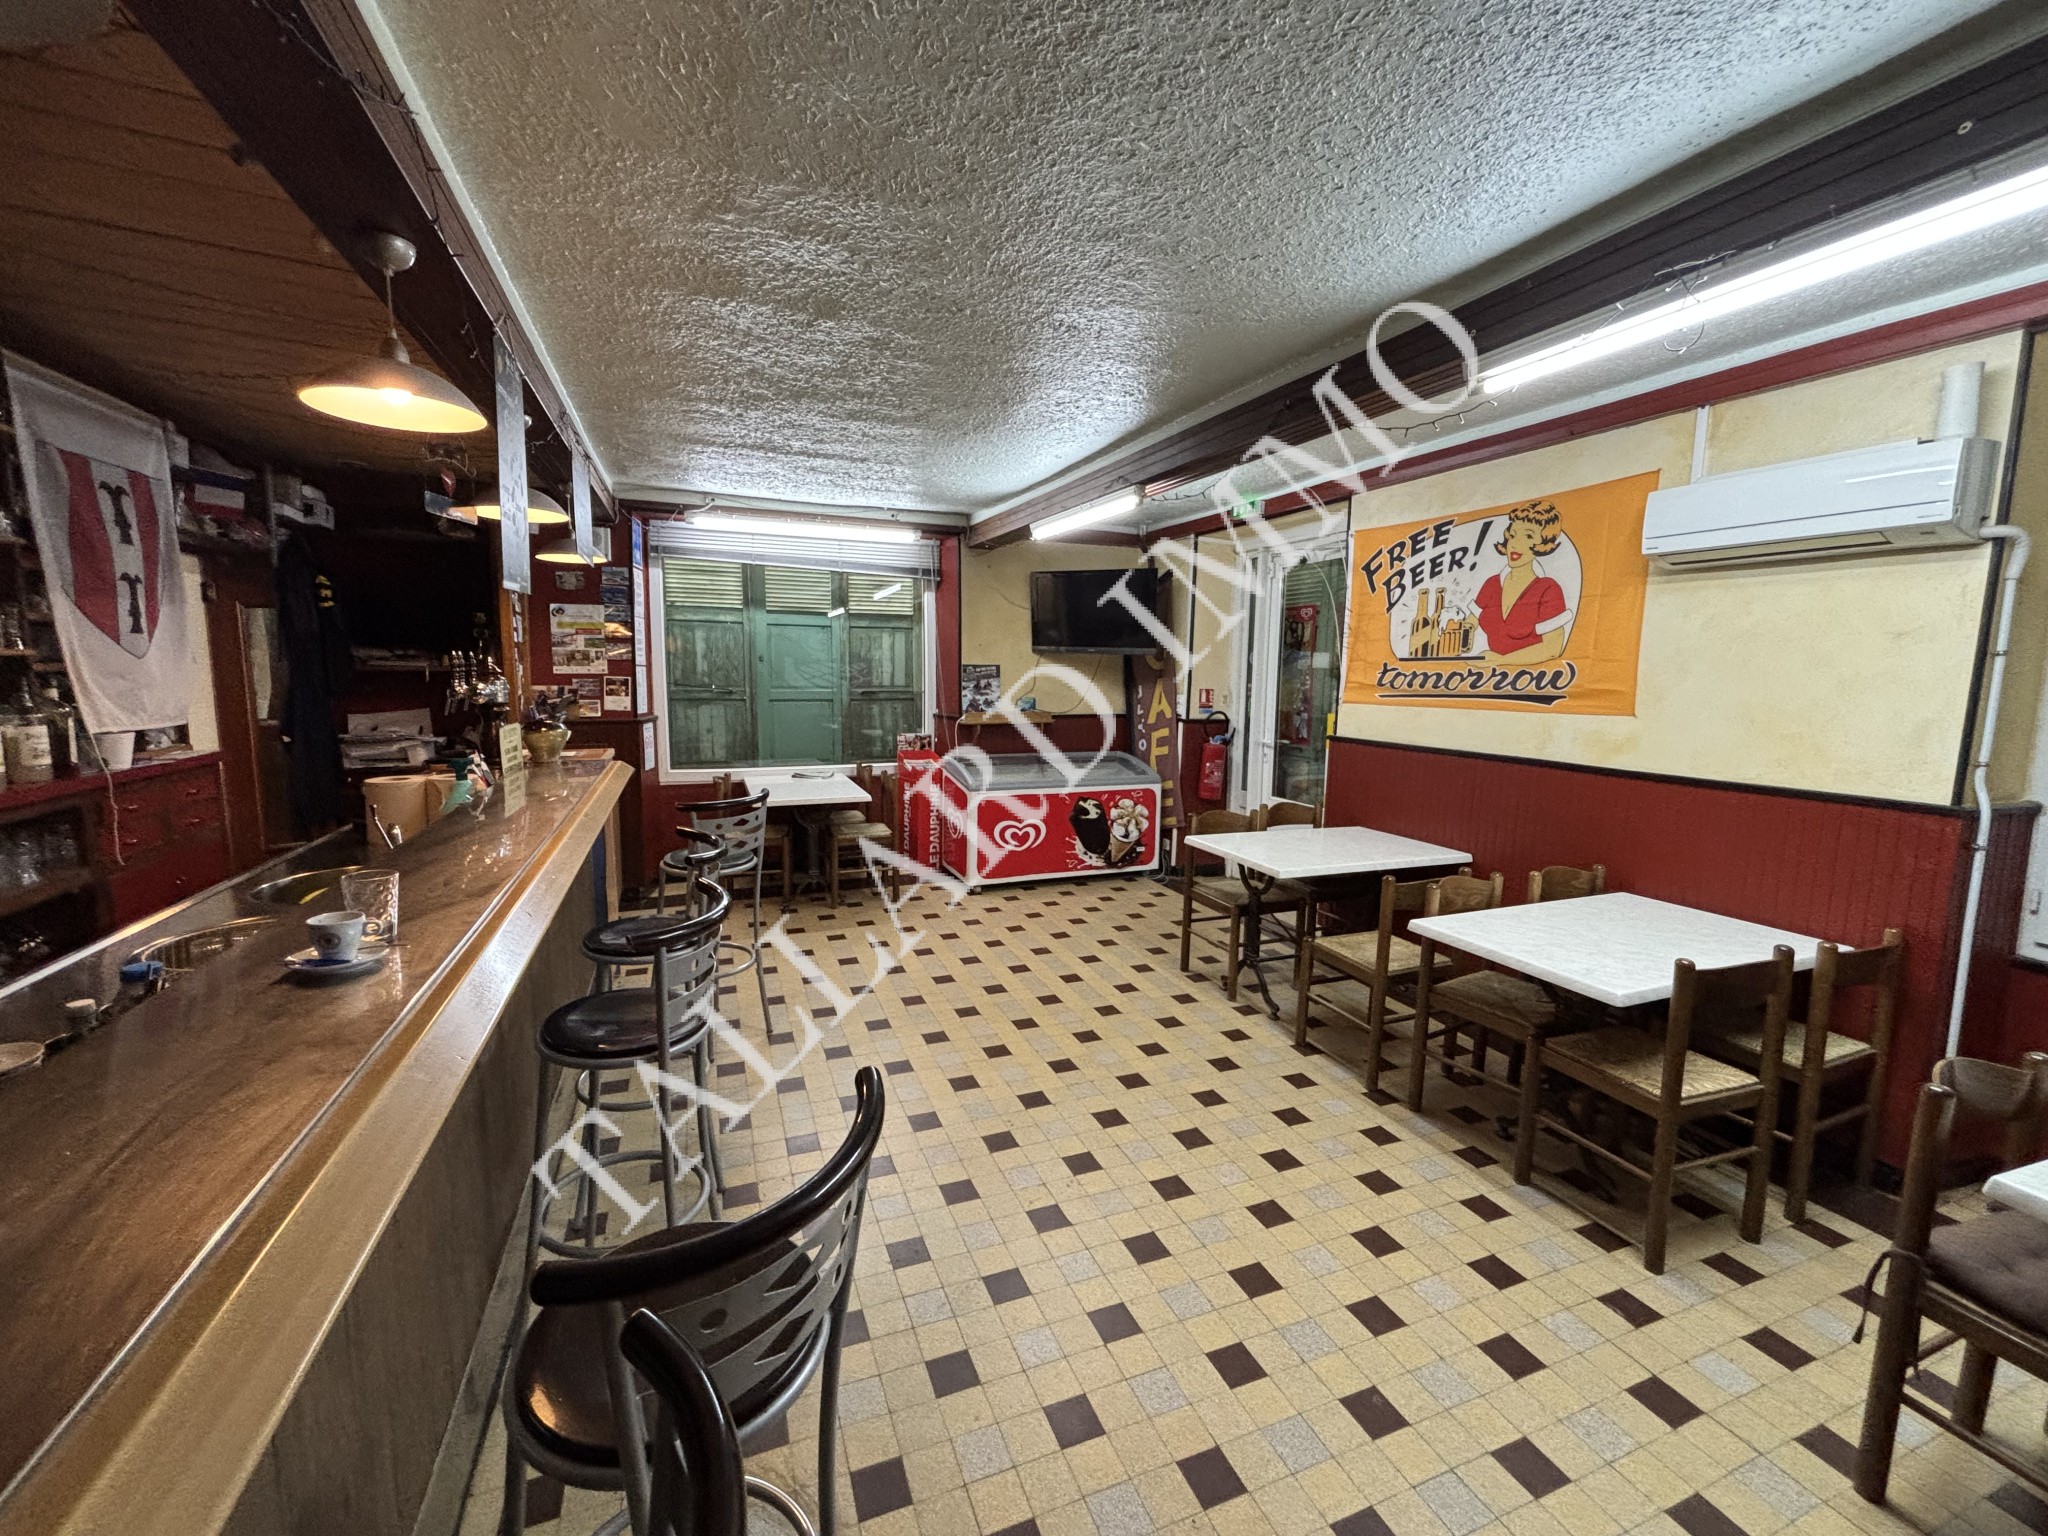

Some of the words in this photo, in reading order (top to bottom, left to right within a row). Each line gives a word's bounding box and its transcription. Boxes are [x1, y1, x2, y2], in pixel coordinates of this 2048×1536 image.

[1362, 518, 1456, 594] FREE
[1382, 519, 1494, 614] BEER!
[1376, 661, 1576, 691] tomorrow
